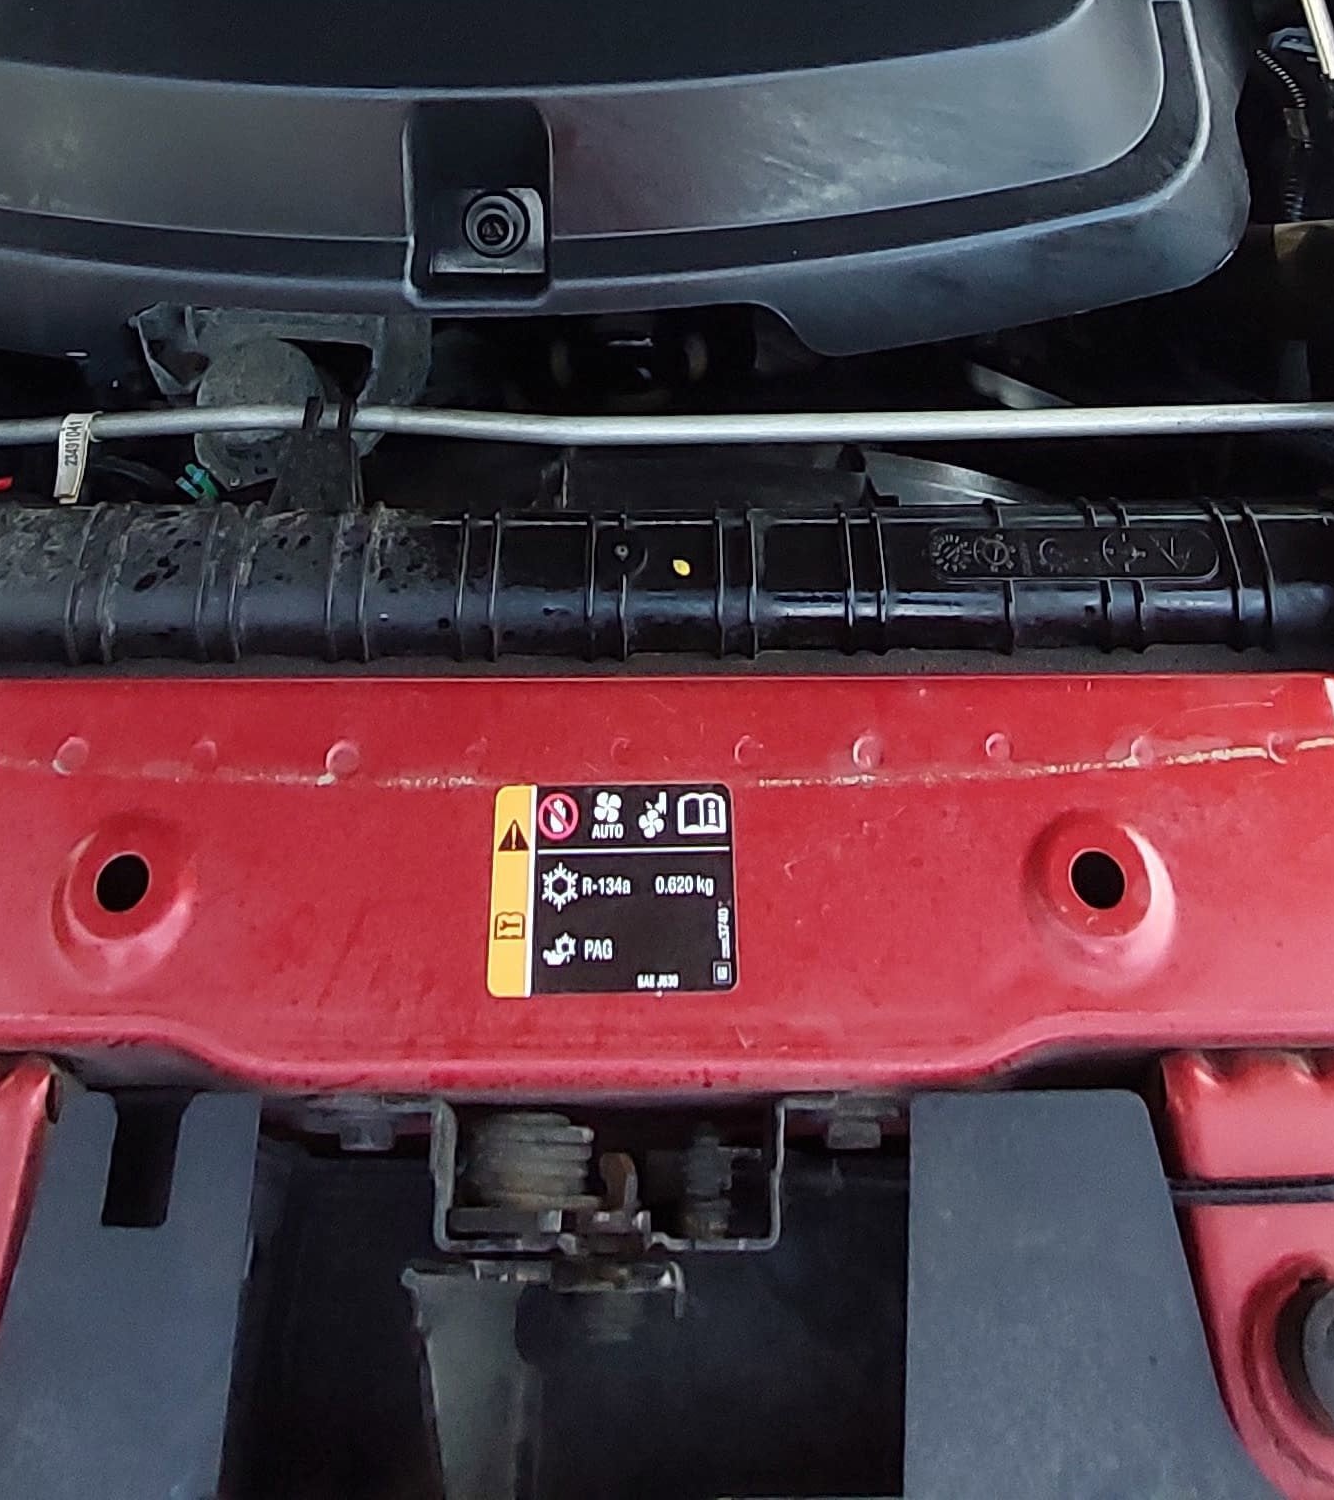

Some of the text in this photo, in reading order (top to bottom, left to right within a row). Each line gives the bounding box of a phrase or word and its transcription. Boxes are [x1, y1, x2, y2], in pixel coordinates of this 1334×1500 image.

[591, 823, 624, 840] AUTO
[582, 874, 714, 897] R-134a 0.620 kg
[584, 938, 613, 960] PAG
